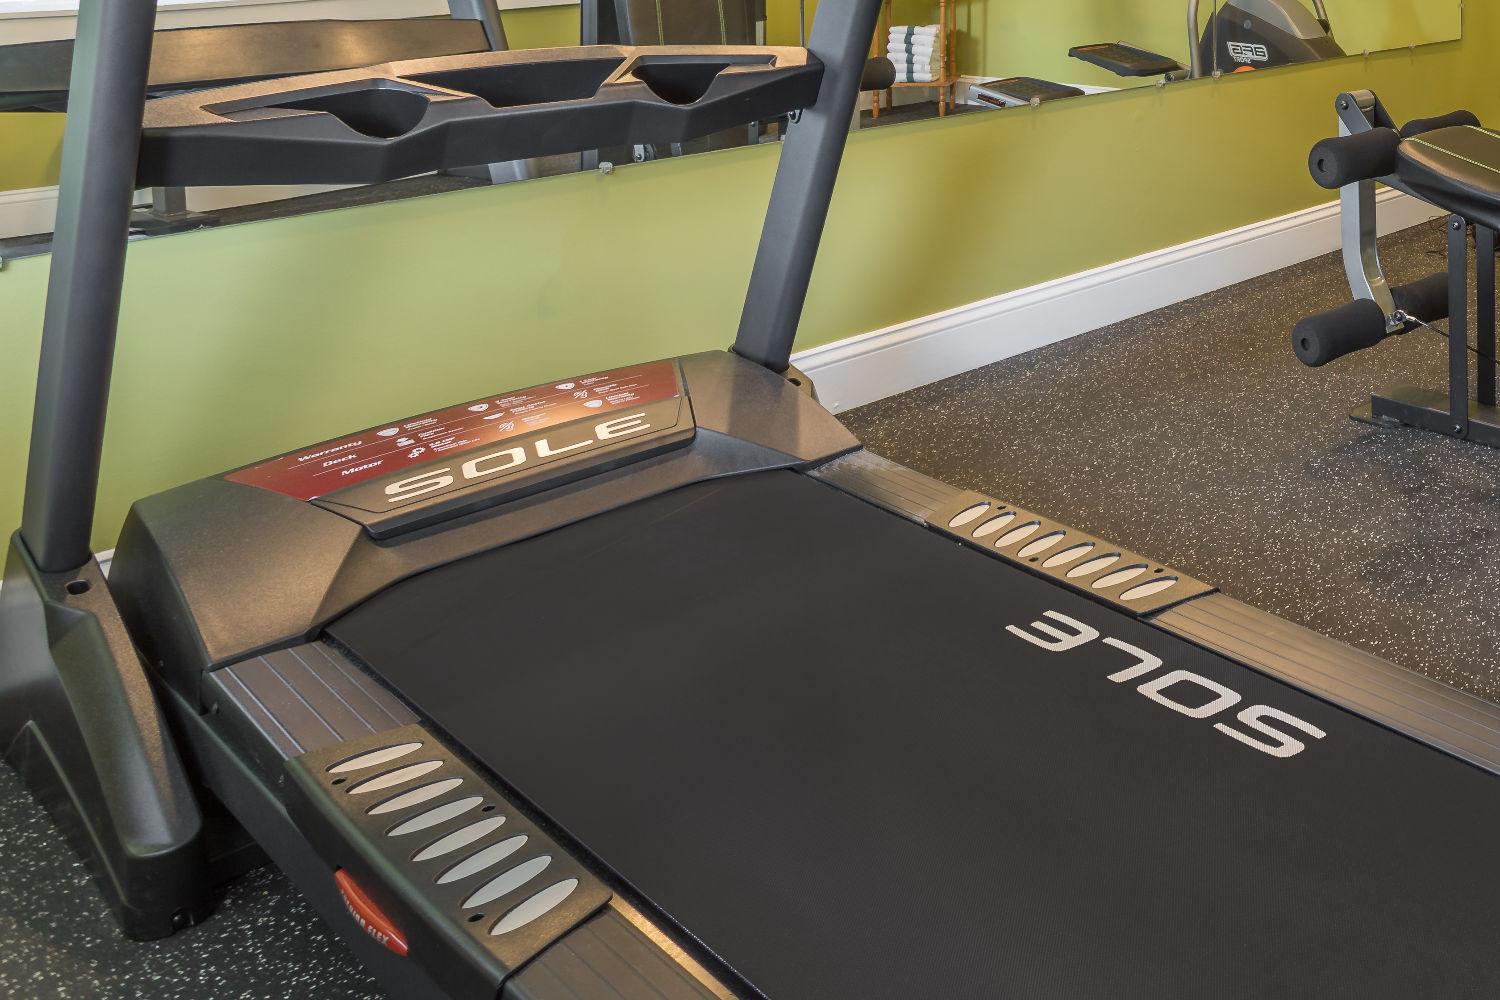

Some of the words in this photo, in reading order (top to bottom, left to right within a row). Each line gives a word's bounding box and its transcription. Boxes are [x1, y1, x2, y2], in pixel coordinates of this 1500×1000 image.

[298, 440, 362, 462] Warranty
[323, 453, 357, 467] Deck
[385, 412, 652, 502] SOLE
[342, 460, 384, 476] Motor
[1005, 610, 1327, 758] SOLE
[367, 925, 390, 945] FLEX
